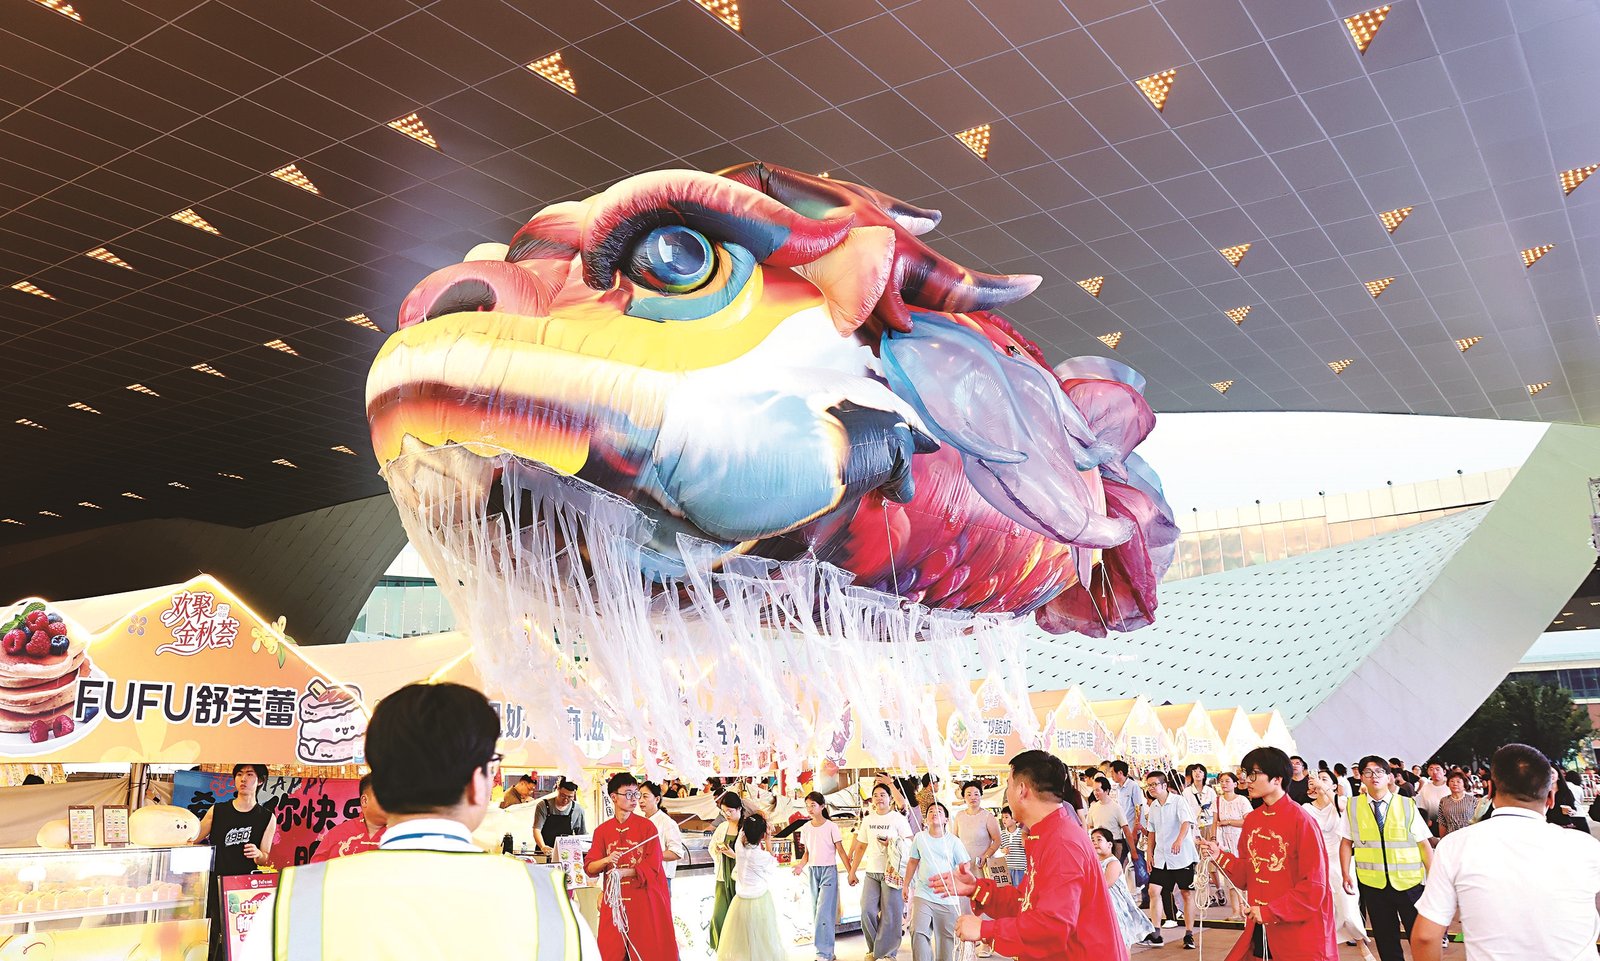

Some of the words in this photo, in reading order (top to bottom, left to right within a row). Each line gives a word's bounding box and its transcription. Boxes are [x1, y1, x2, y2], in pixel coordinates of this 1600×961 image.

[163, 593, 216, 625] 欢聚
[165, 620, 238, 649] 金秋荟
[75, 679, 297, 727] FUFU舒芙蕾
[993, 875, 1009, 884] 自由
